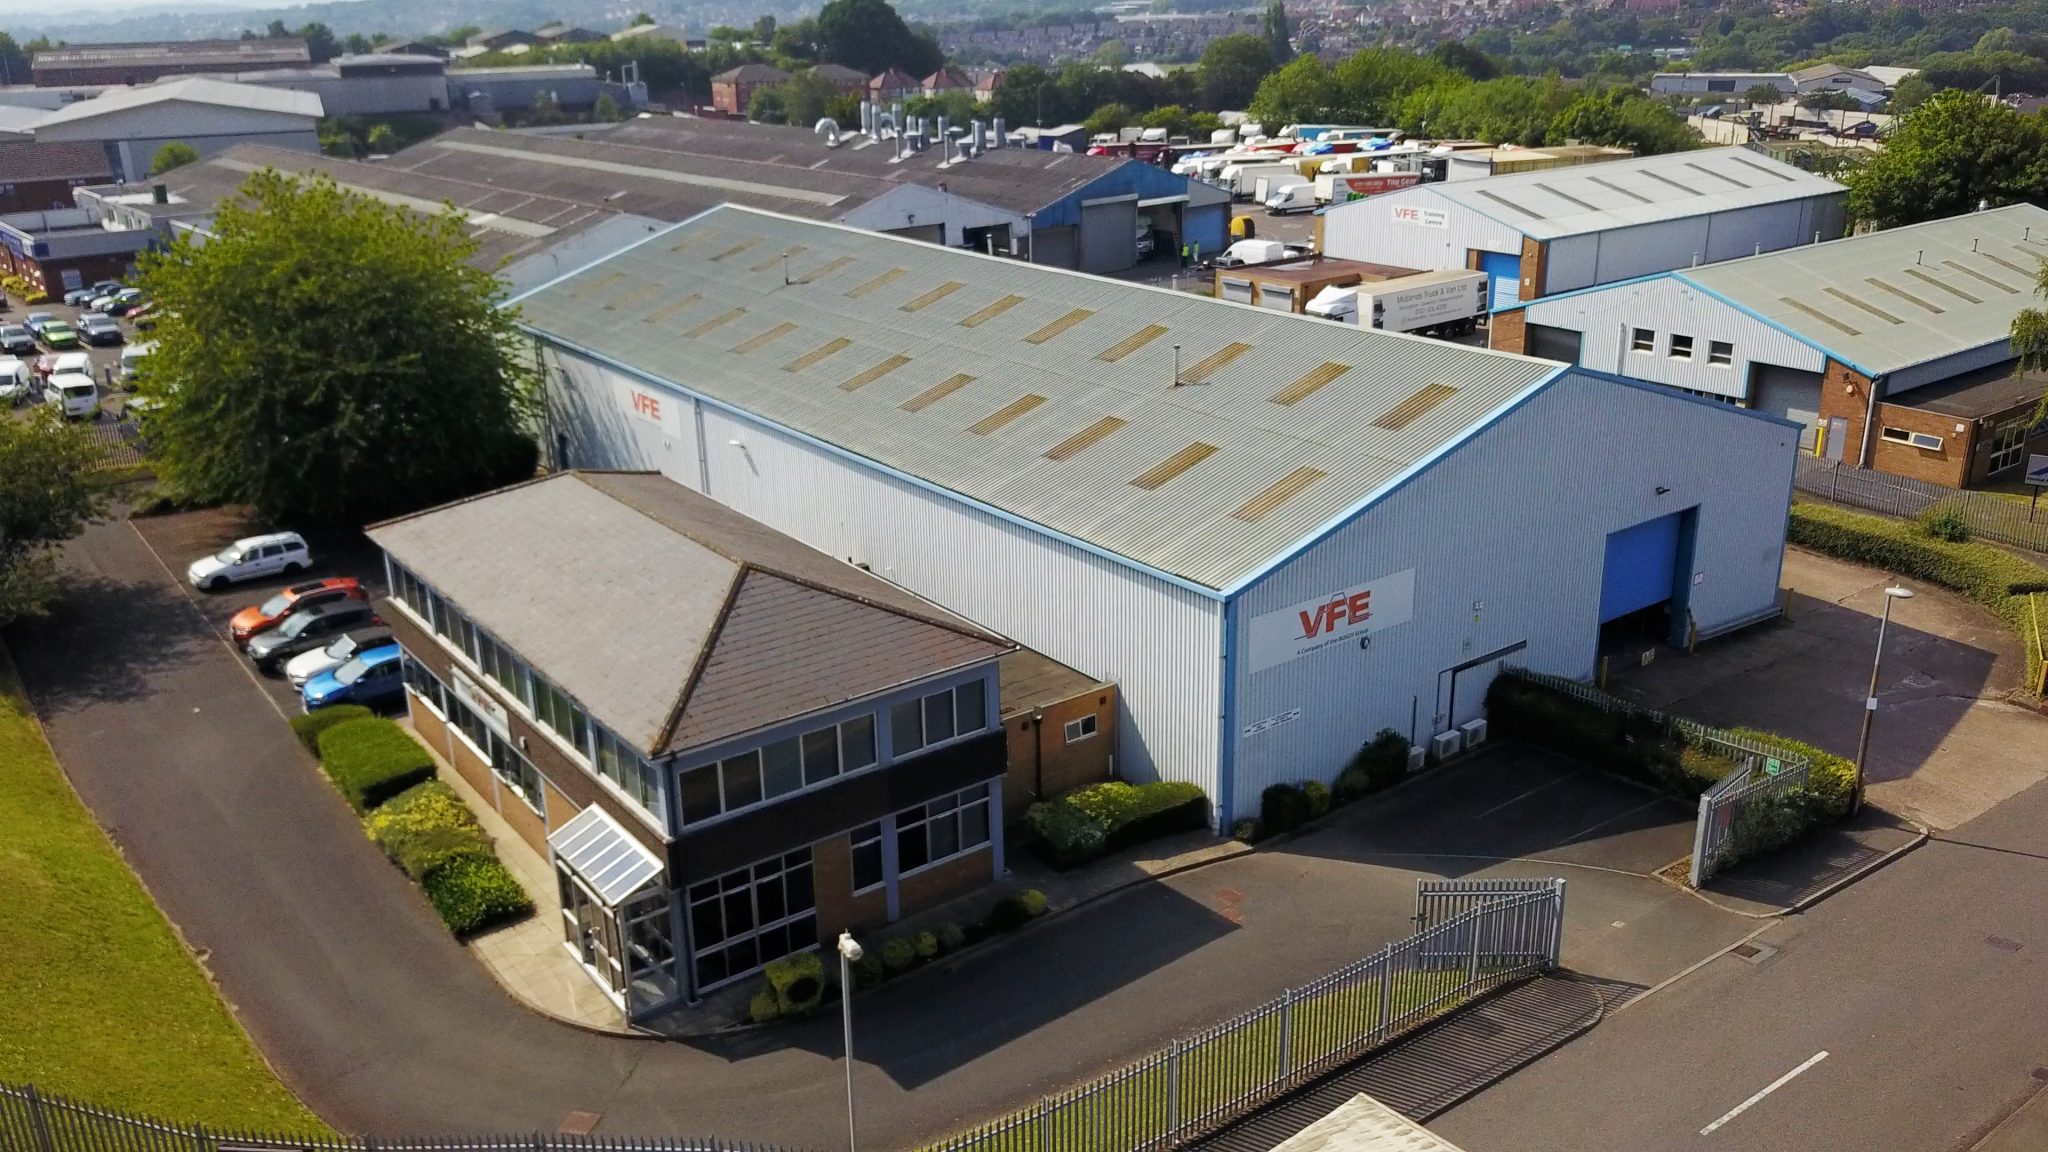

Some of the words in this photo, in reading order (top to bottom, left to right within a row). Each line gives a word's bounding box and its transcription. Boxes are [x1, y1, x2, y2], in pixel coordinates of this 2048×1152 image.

[1395, 208, 1418, 220] VFE
[1423, 210, 1445, 219] Training
[1397, 293, 1422, 303] Midlands
[1445, 286, 1456, 294] Van
[631, 390, 661, 420] VFE
[1298, 590, 1371, 639] VFE
[1301, 643, 1323, 654] Company
[1324, 639, 1330, 647] of
[1330, 637, 1338, 645] the
[1355, 628, 1369, 636] Group
